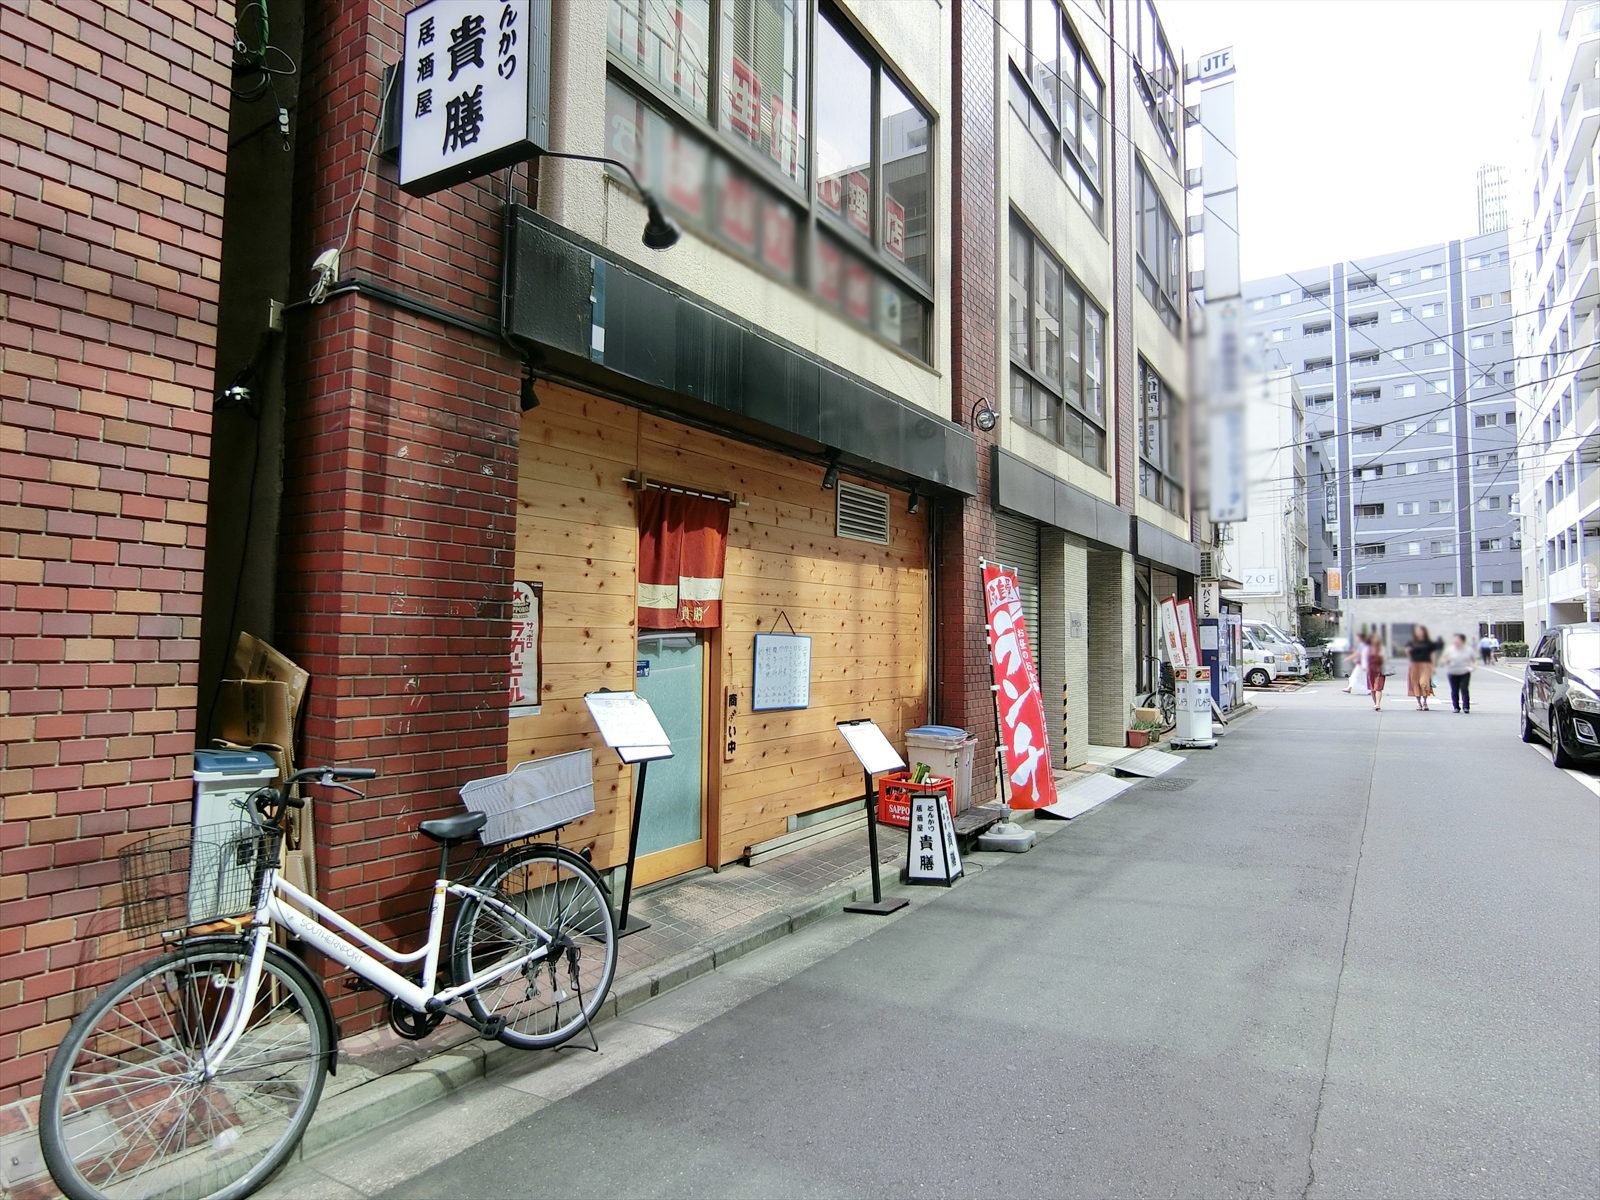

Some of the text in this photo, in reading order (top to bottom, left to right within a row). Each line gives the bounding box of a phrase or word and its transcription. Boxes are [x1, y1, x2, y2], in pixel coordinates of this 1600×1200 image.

[498, 0, 518, 80] んかつ
[415, 16, 436, 119] 居酒屋
[1204, 52, 1230, 72] JTF
[442, 15, 487, 156] 貴膳
[1327, 487, 1337, 520] 小林歯科
[512, 605, 530, 614] PPORO
[1203, 589, 1211, 618] パンドラ
[526, 621, 534, 649] サッポロ
[509, 621, 525, 703] ラガービール
[993, 602, 1045, 802] ランチ
[889, 804, 910, 815] SAPPO
[915, 804, 924, 832] 居酒屋
[927, 804, 936, 833] とんかつ
[919, 834, 935, 871] 貴膳
[300, 918, 364, 963] SOUTHERNPORT
